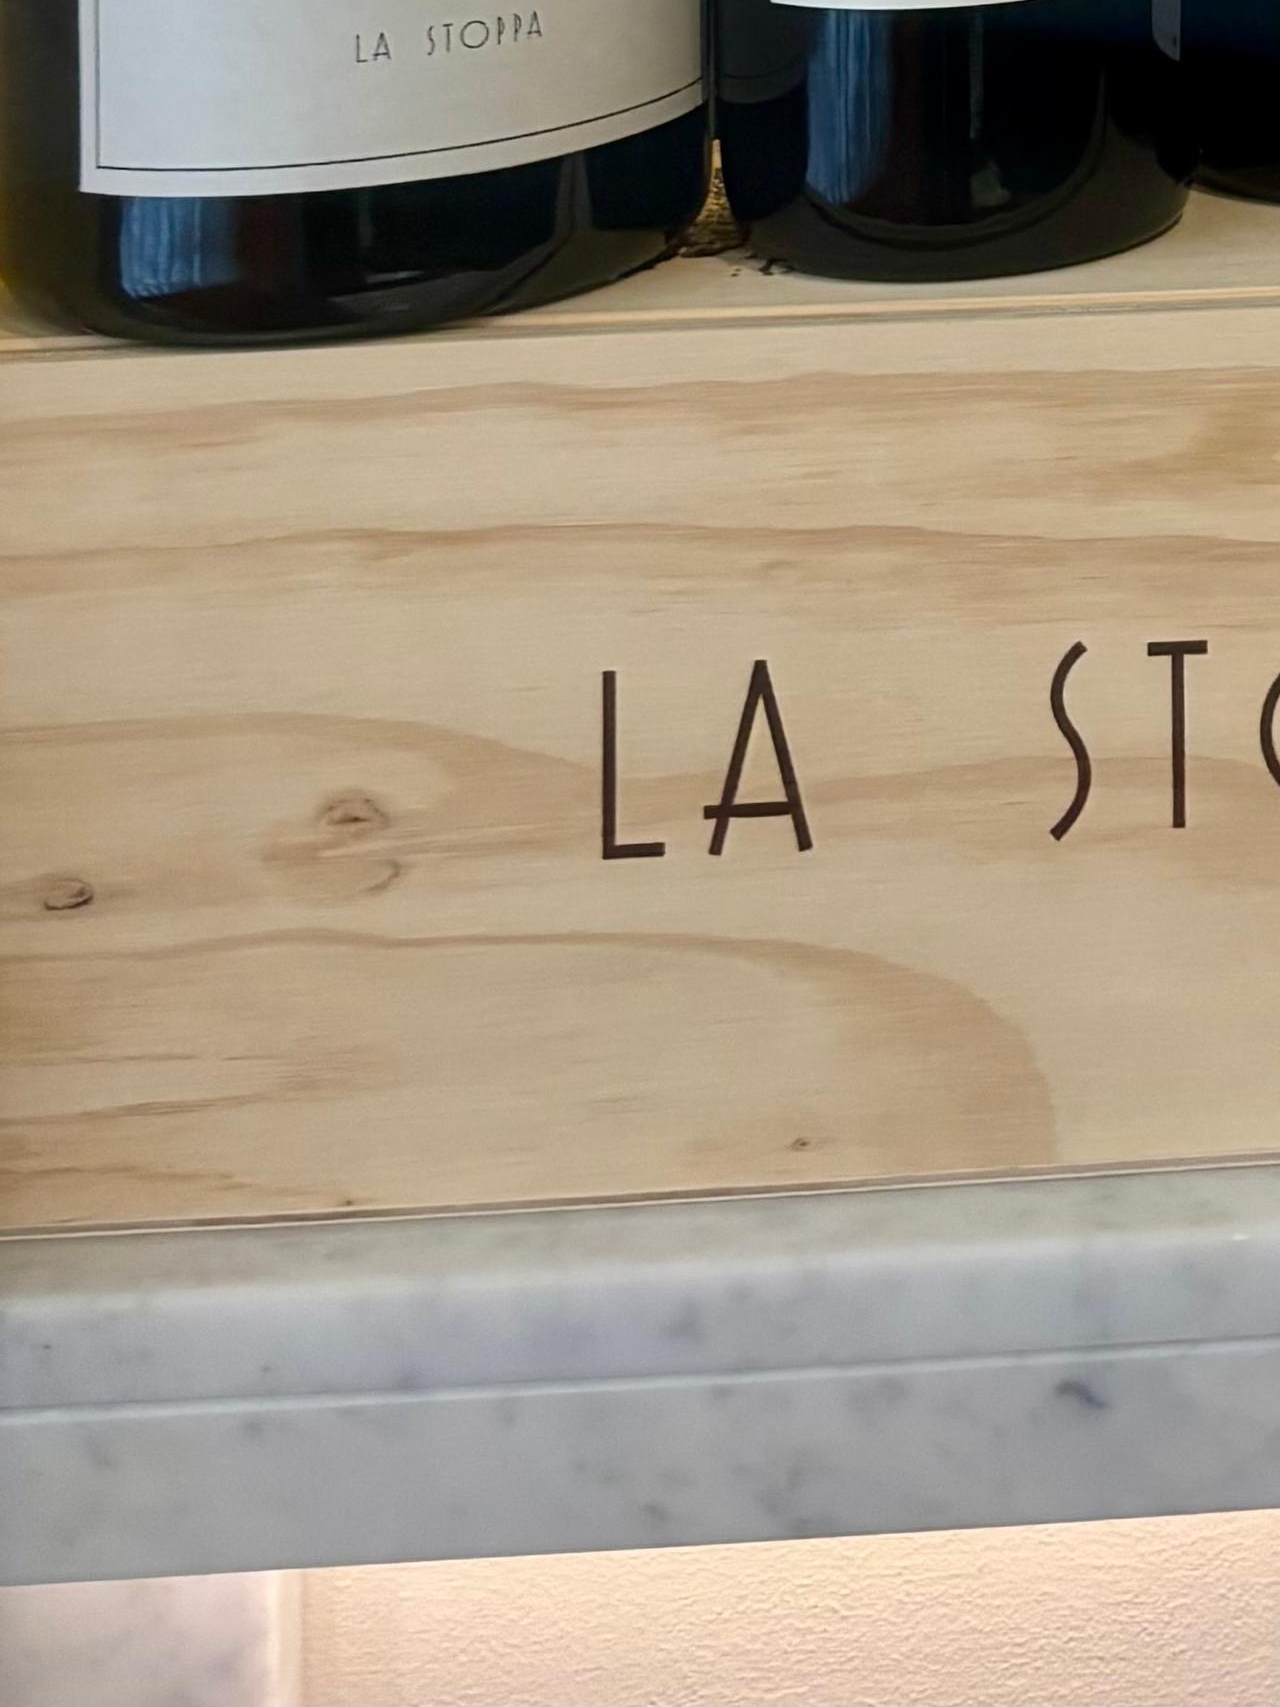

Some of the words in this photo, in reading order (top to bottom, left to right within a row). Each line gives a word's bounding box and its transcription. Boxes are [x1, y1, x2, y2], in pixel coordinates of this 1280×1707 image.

[355, 32, 393, 64] LA
[426, 11, 543, 56] STOPPA
[600, 659, 814, 861] LA
